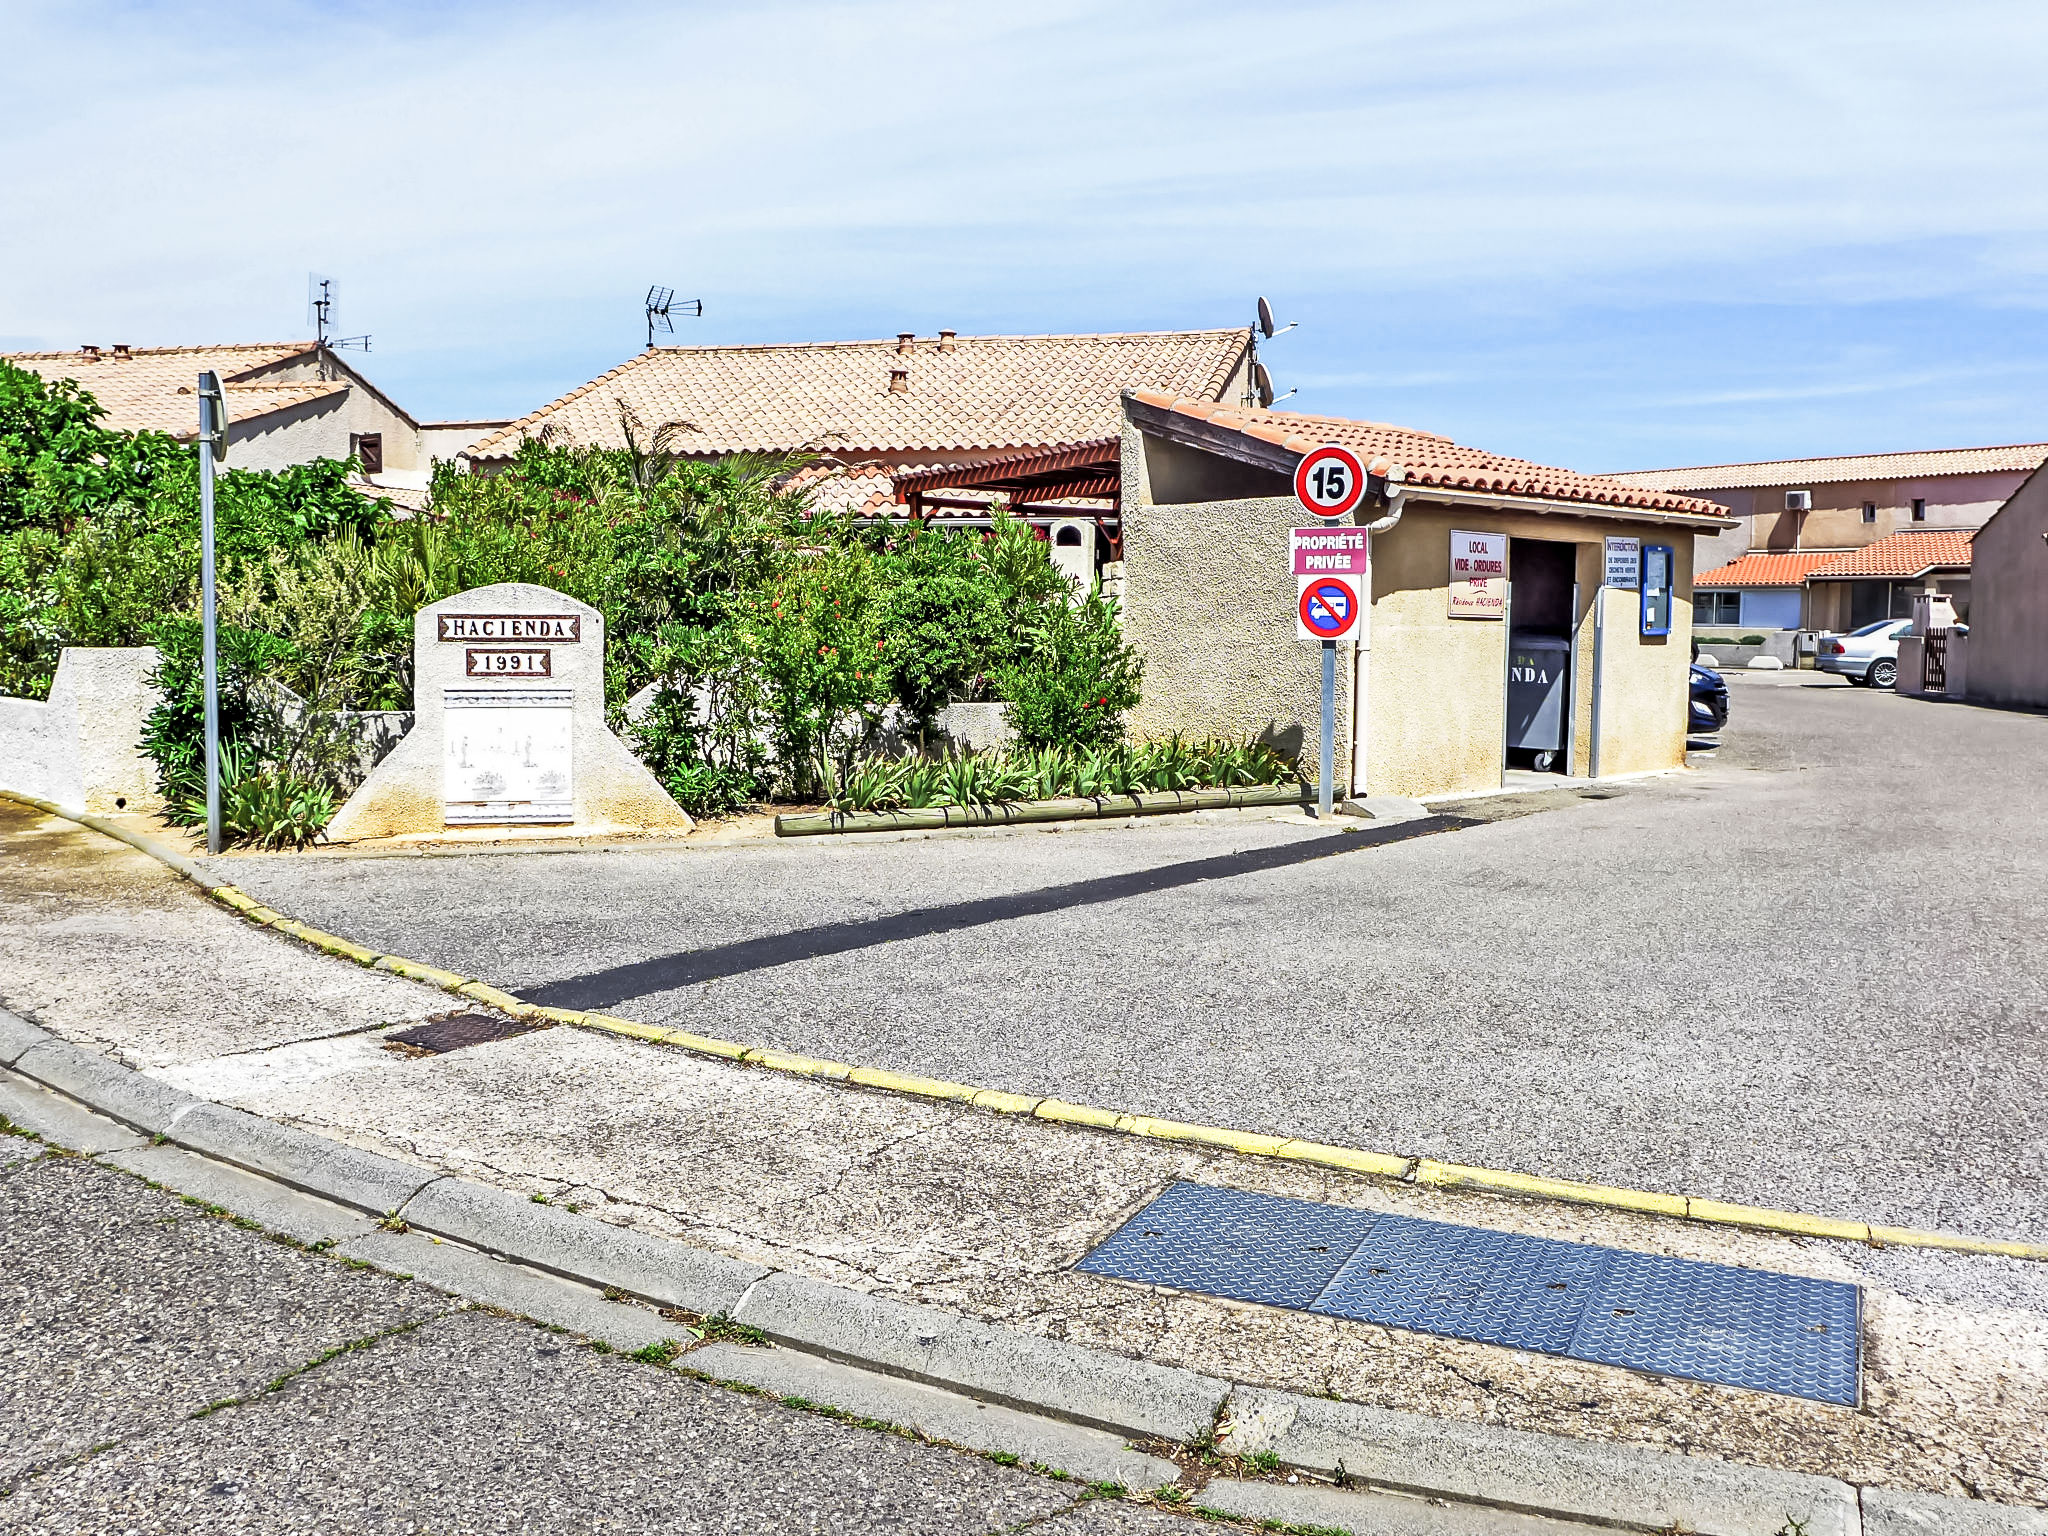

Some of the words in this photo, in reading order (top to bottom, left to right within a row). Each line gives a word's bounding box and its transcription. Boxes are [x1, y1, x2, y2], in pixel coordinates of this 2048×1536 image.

[1312, 466, 1345, 499] 15
[1294, 532, 1364, 550] PROPRIÉTÉ
[1469, 540, 1488, 554] LOCAL
[1305, 552, 1352, 569] PRIVÉE
[1454, 558, 1469, 571] VIDE
[1473, 559, 1502, 573] ORDURES
[453, 620, 565, 637] HACIENDA
[485, 655, 534, 670] 1991
